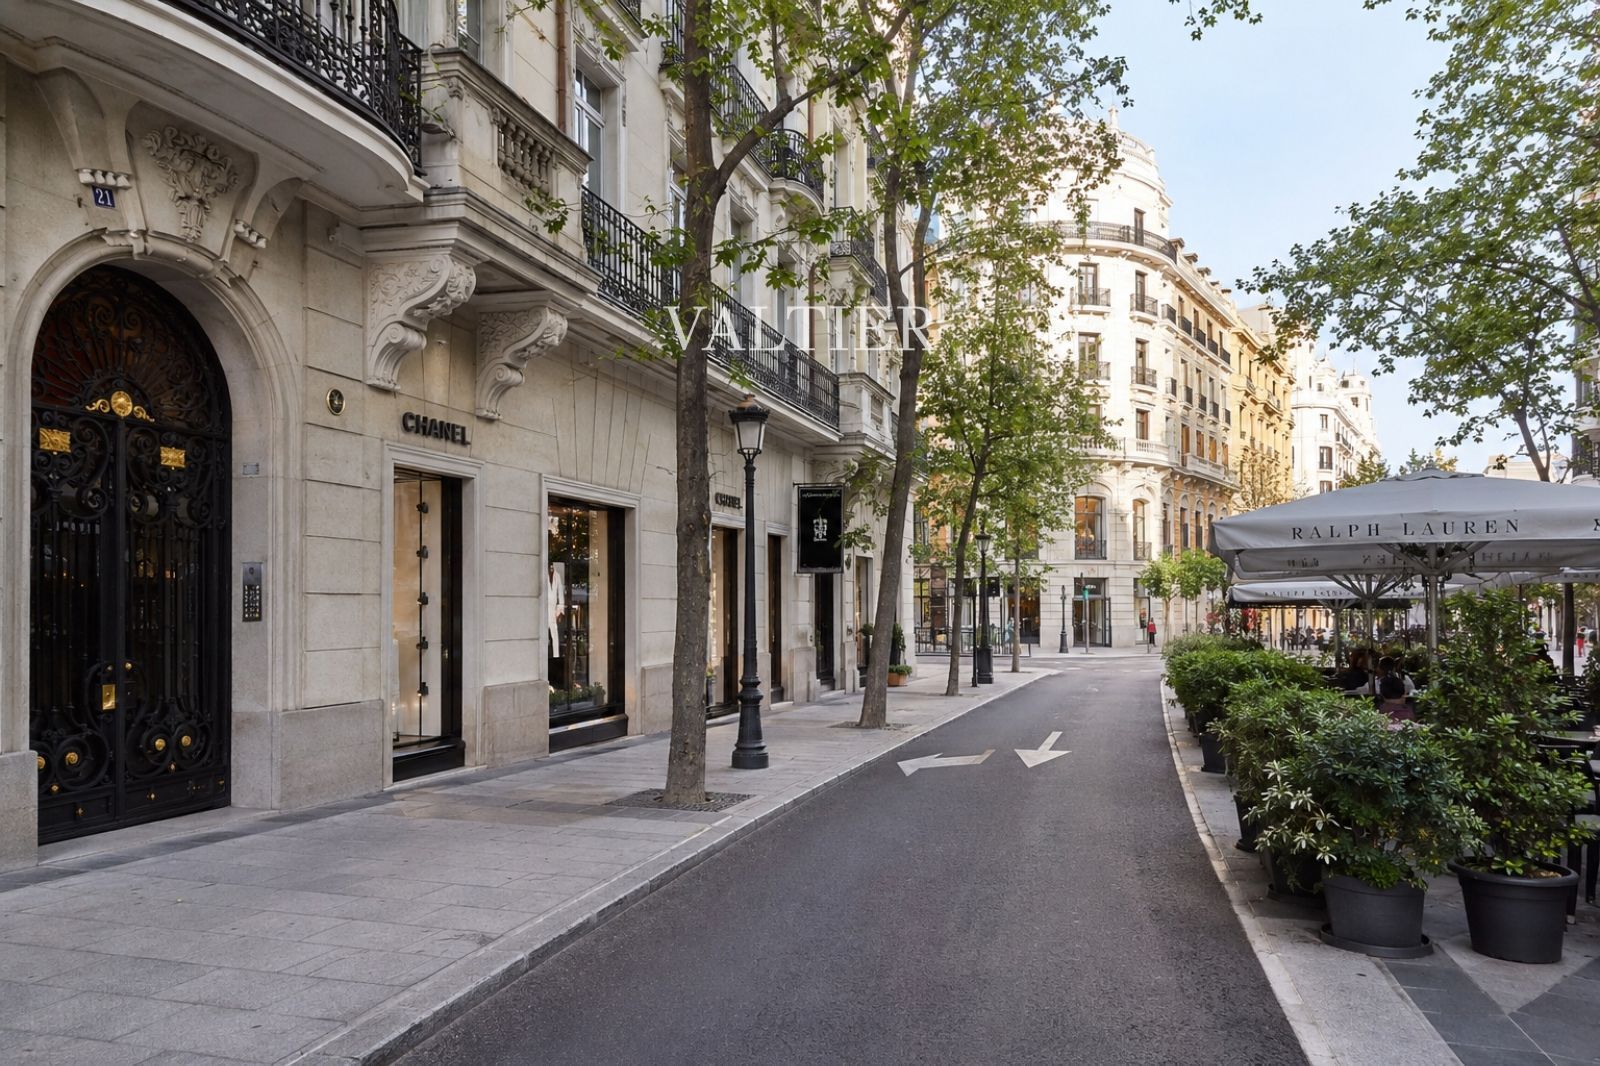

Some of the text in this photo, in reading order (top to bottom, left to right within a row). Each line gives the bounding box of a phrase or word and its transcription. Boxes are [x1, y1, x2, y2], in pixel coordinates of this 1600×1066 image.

[95, 188, 112, 206] 21
[402, 411, 471, 446] CHANEL
[1291, 519, 1519, 540] RALPH LAUREN
